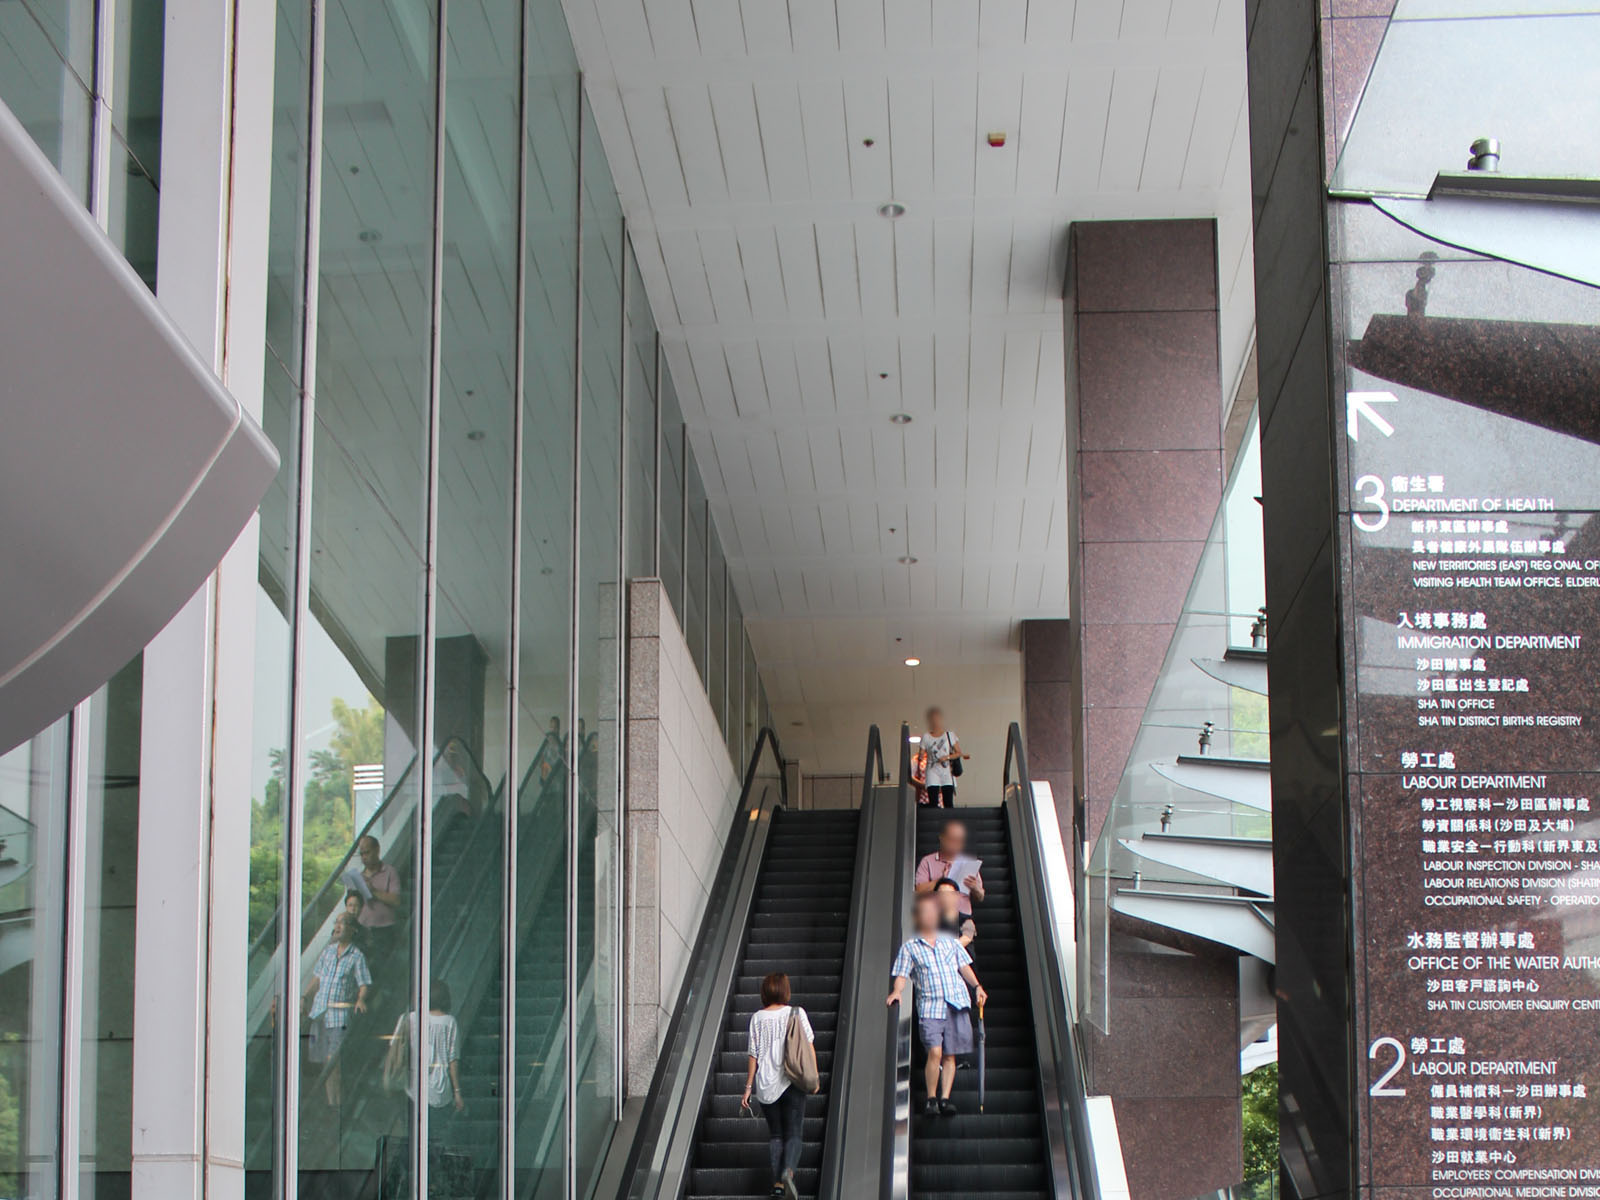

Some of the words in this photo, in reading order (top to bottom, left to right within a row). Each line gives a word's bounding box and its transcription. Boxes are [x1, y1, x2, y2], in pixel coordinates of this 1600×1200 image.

[1353, 475, 1390, 532] 3
[1393, 499, 1478, 511] DEPARTMENT
[1482, 499, 1502, 511] OF
[1413, 560, 1436, 570] NEW
[1439, 560, 1496, 570] TERRITORIES
[1531, 560, 1582, 570] REGONAL
[1413, 577, 1453, 588] VISITING
[1456, 577, 1492, 588] HEALTH
[1495, 577, 1521, 588] TEAM
[1524, 577, 1563, 588] OFFICE,
[1397, 612, 1487, 629] 入境事務處
[1398, 636, 1491, 649] IMMIGRATION
[1496, 636, 1581, 649] DEPARTMENT
[1416, 658, 1486, 671] 沙田辦事處
[1417, 679, 1529, 692] 沙田區出生登記處
[1418, 699, 1438, 709] SHA
[1441, 699, 1455, 709] TIN
[1458, 699, 1495, 709] OFFICE
[1418, 716, 1438, 726] SHA
[1441, 716, 1455, 726] TIN
[1459, 716, 1500, 726] DISTRICT
[1503, 716, 1534, 726] BIRTHS
[1537, 716, 1582, 726] REGISTRY
[1401, 752, 1456, 769] 勞工處
[1403, 776, 1456, 789] LABOUR
[1461, 776, 1547, 789] DEPARTMENT
[1424, 861, 1464, 871] LABOUR
[1467, 861, 1525, 871] INSPECTION
[1529, 861, 1572, 871] DIVISION
[1424, 878, 1464, 888] LABOUR
[1467, 878, 1519, 888] RELATIONS
[1522, 878, 1564, 888] DIVISION
[1425, 896, 1504, 906] OCCUPATIONAL
[1507, 896, 1541, 906] SAFETY
[1407, 932, 1535, 949] 水務監督辦事處
[1408, 956, 1458, 970] OFFICE
[1463, 956, 1483, 970] OF
[1487, 956, 1510, 970] THE
[1515, 956, 1559, 970] WATER
[1563, 956, 1600, 970] AUTH
[1427, 1000, 1447, 1011] SHA
[1451, 1000, 1465, 1011] TIN
[1468, 1000, 1523, 1011] CUSTOMER
[1526, 1000, 1569, 1011] ENQUIRY
[1572, 1000, 1600, 1011] CENT
[1411, 1037, 1465, 1055] 勞工處
[1369, 1036, 1407, 1097] 2
[1412, 1062, 1466, 1075] LABOUR
[1471, 1062, 1557, 1075] DEPARTMENT
[1432, 1151, 1516, 1164] 沙田就業中心
[1495, 1170, 1577, 1181] COMPENSATION
[1580, 1170, 1600, 1181] DIVI
[1433, 1188, 1513, 1198] OCCUPATIONAL
[1516, 1188, 1566, 1198] MEDICINE
